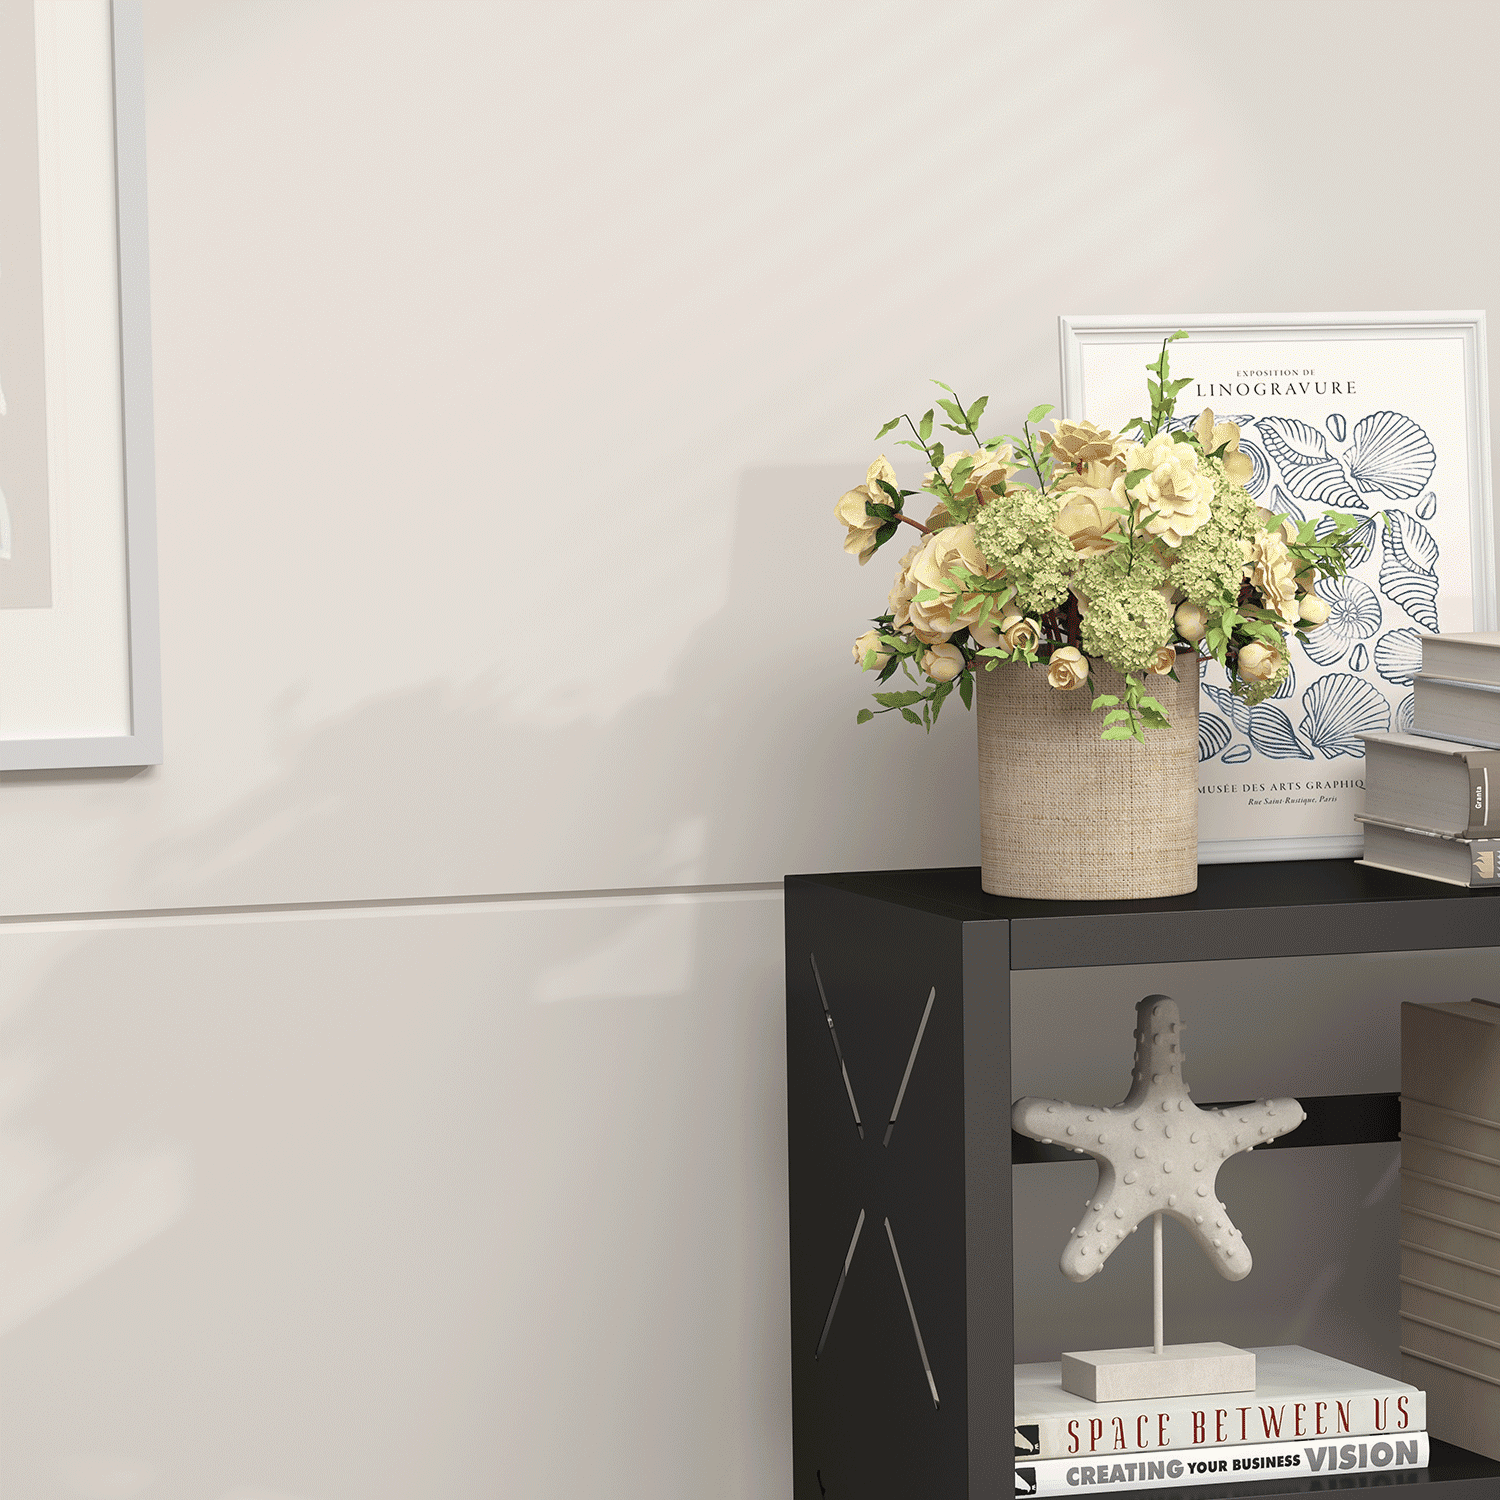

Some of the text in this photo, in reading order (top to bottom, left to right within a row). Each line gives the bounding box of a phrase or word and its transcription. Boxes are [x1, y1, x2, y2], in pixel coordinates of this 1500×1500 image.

[1236, 369, 1299, 377] EXPOSITION
[1196, 381, 1357, 397] LINOGRAVURE
[1242, 783, 1265, 793] DES
[1270, 781, 1302, 791] ARTS
[1248, 798, 1262, 806] Rue
[1319, 795, 1338, 803] Paris
[1067, 1395, 1409, 1454] SPACE BETWEEN US
[1066, 1439, 1418, 1487] CREATING YOUR BUSINESS VISION
